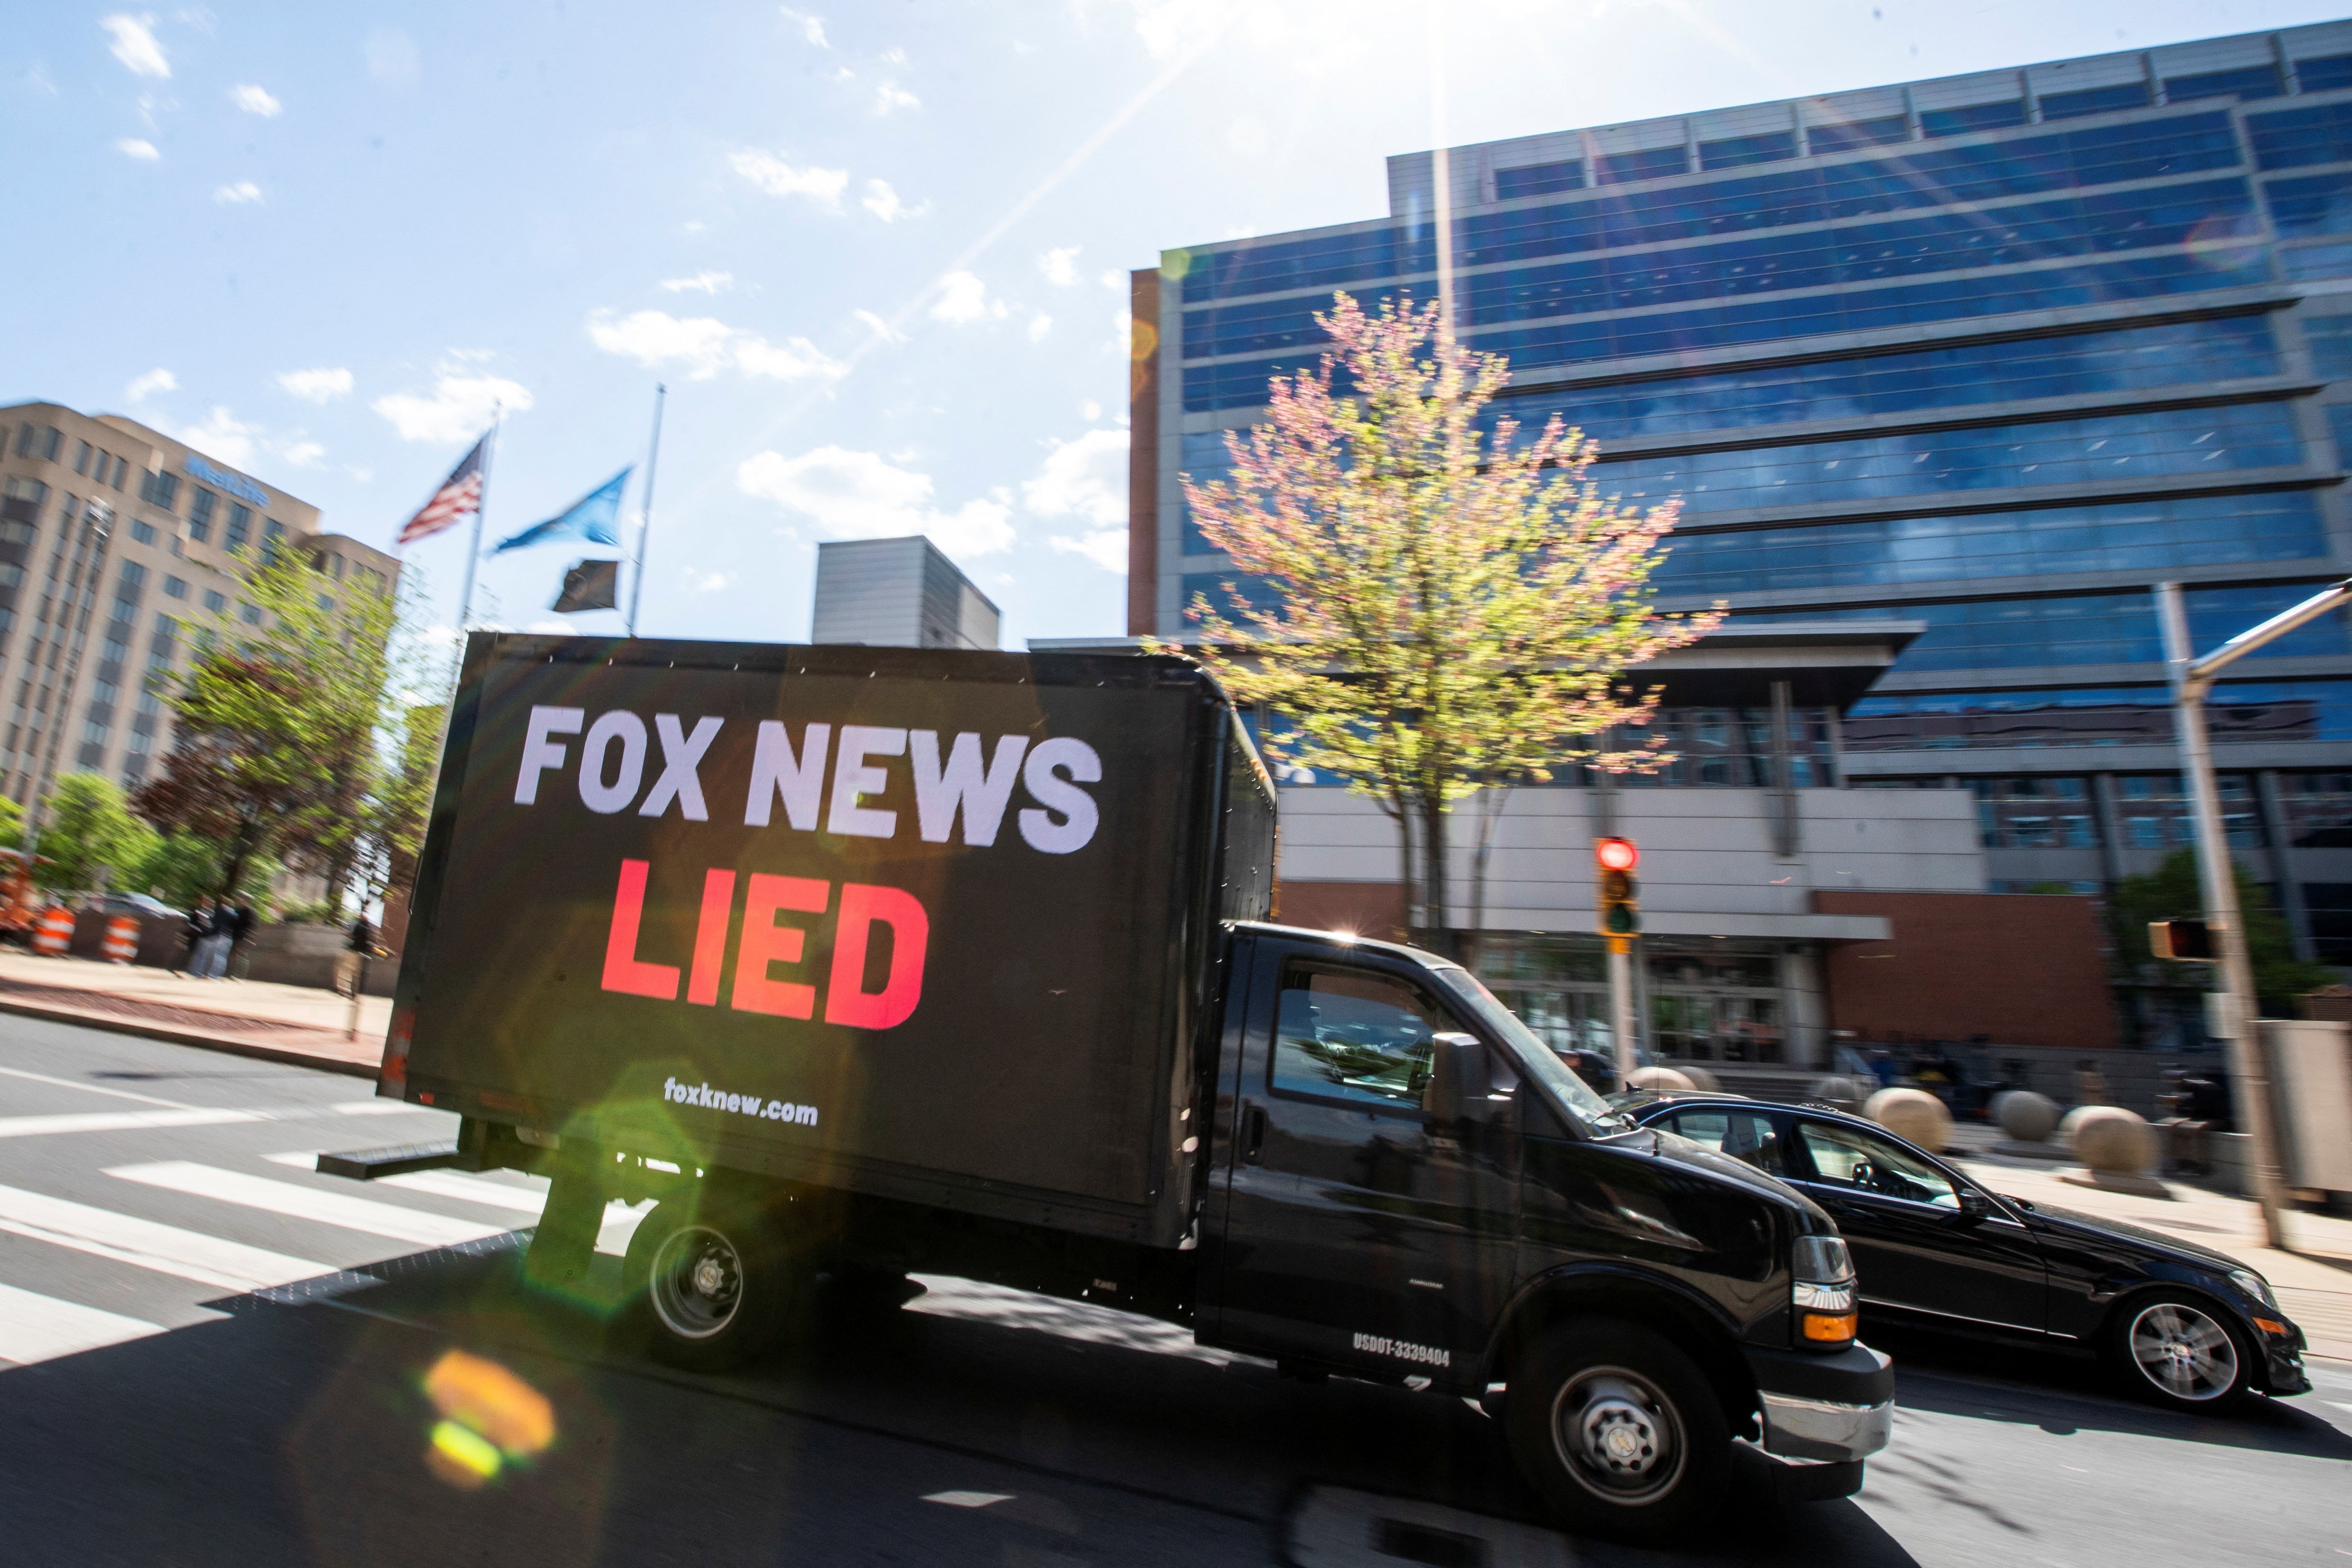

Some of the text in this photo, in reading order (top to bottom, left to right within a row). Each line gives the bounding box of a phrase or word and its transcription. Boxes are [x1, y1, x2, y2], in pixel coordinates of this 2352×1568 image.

[514, 705, 1102, 854] FOX NEWS
[601, 859, 929, 1030] LIED
[664, 1076, 818, 1126] foxknew.com
[1353, 1332, 1450, 1367] USDOT-3339404
